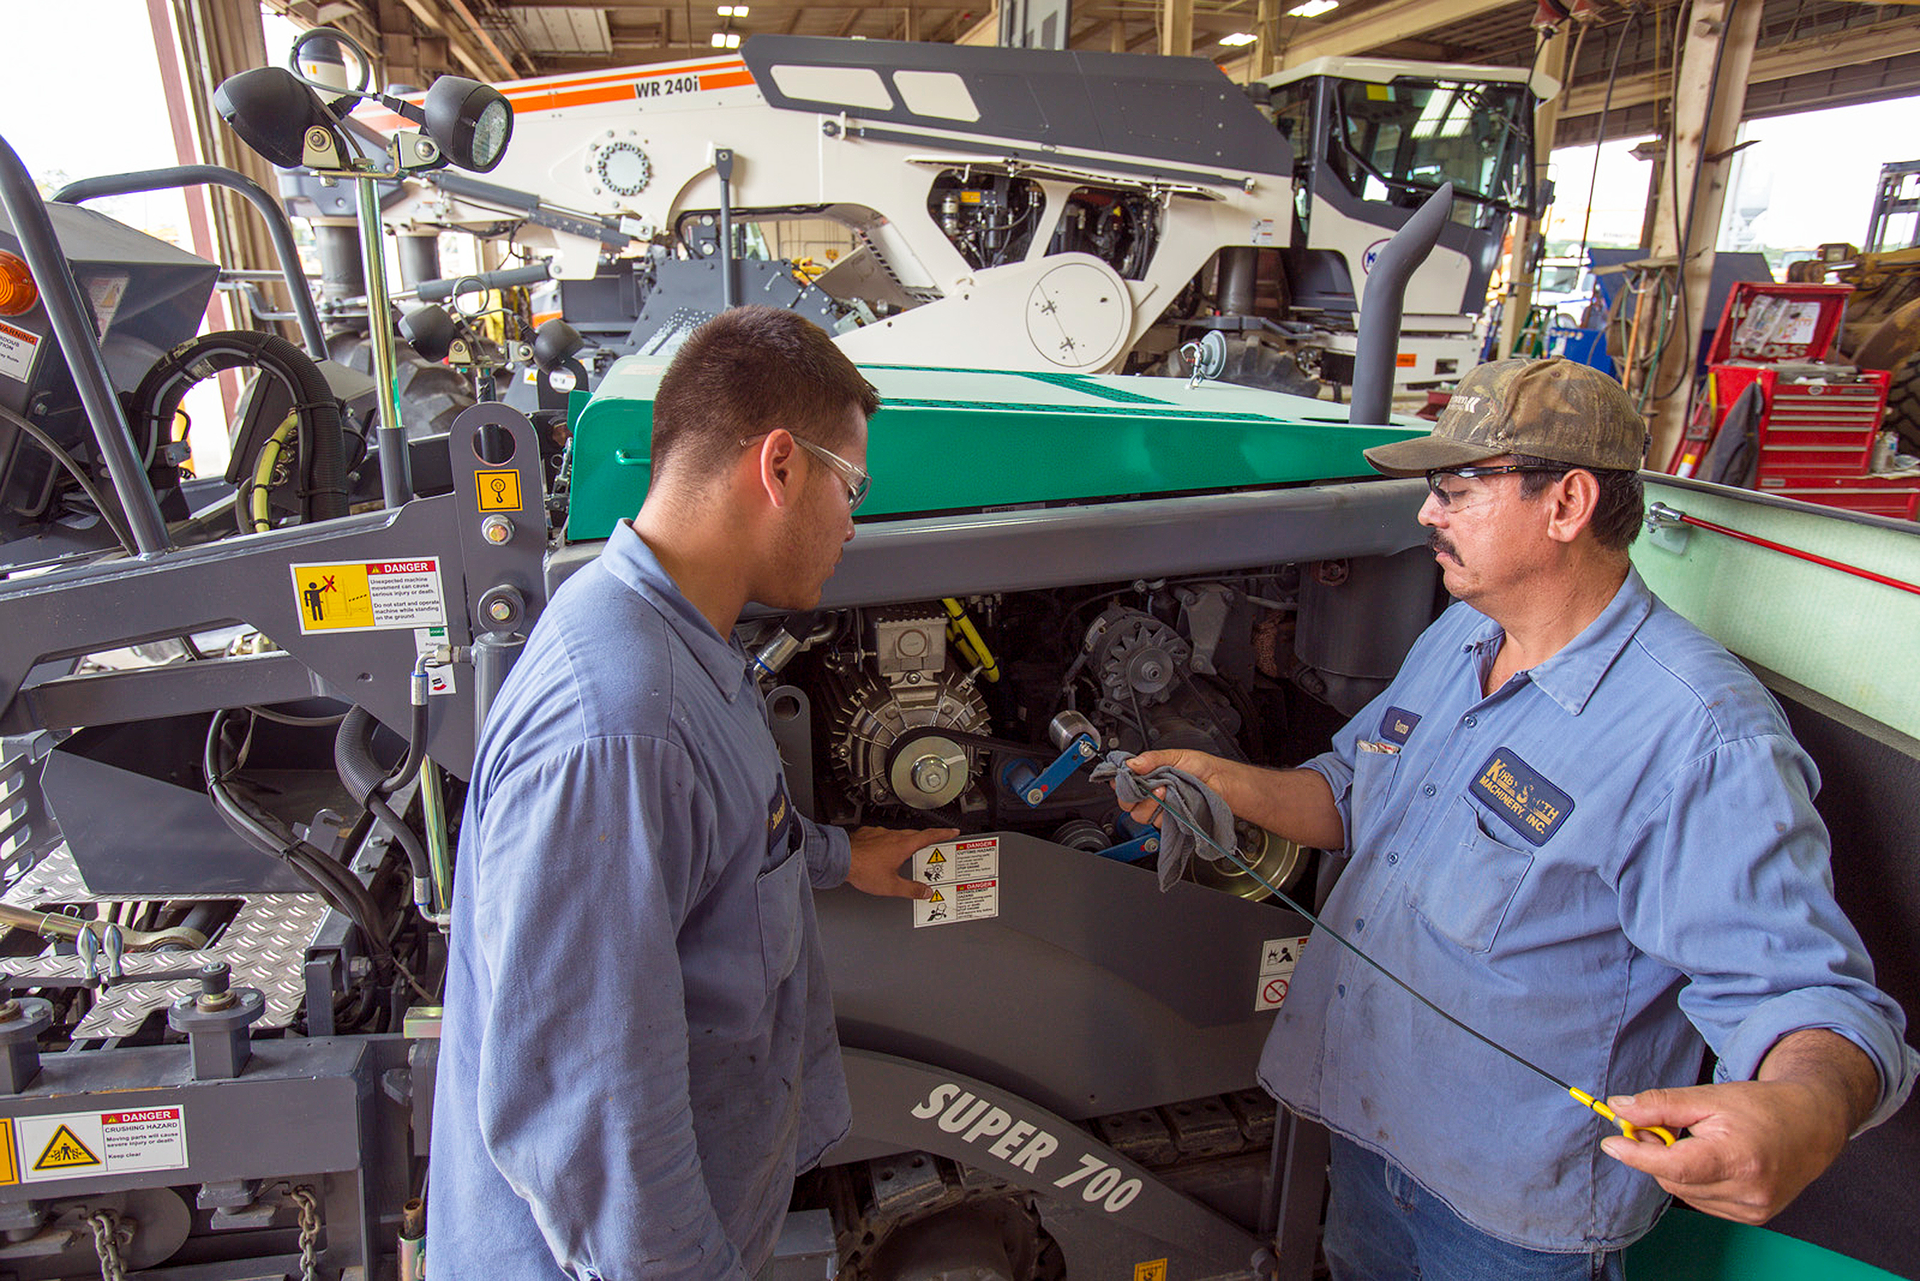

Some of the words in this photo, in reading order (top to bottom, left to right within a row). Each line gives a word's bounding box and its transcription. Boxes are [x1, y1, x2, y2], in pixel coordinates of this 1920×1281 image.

[636, 82, 660, 98] WR
[664, 75, 698, 95] 240i
[384, 563, 428, 572] DANGER
[1479, 775, 1525, 818] MACHINERY,
[1526, 814, 1546, 834] INC.
[122, 1111, 171, 1122] DANGER
[105, 1125, 145, 1133] CRUSHING
[910, 1083, 1058, 1174] SUPER
[1053, 1153, 1142, 1212] 700
